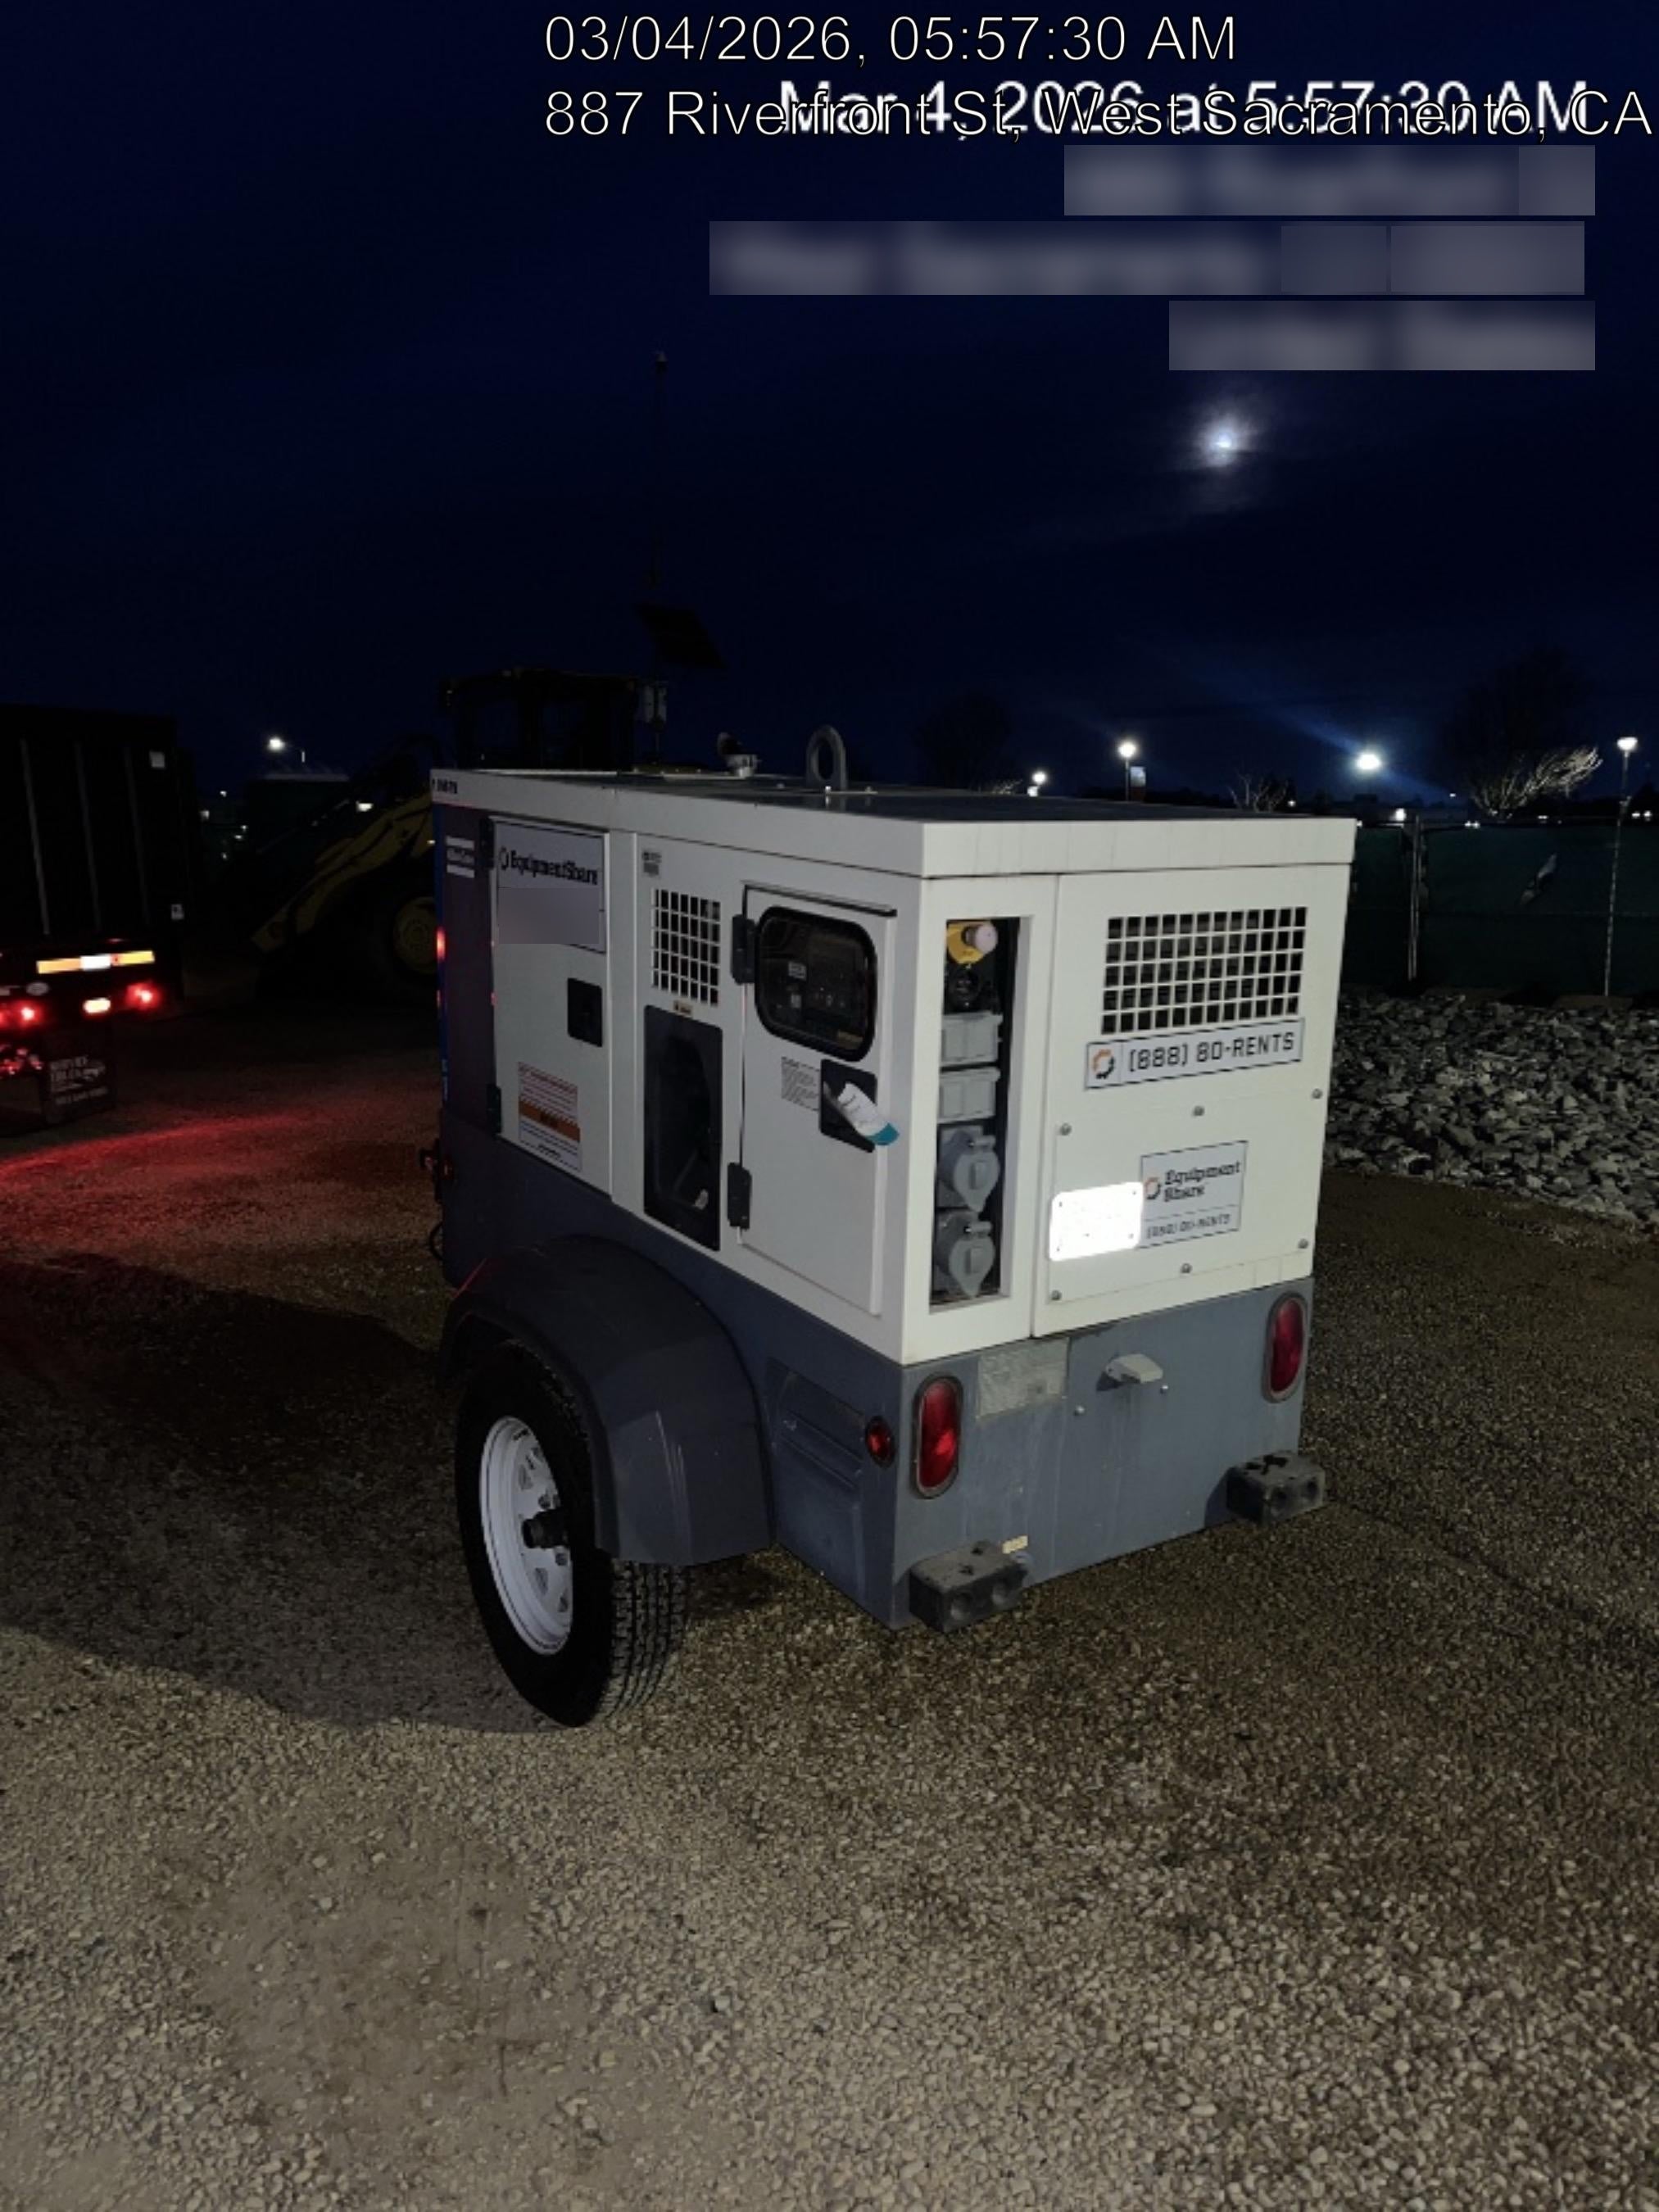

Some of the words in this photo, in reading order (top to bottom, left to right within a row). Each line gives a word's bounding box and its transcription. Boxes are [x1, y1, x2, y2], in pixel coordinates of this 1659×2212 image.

[1196, 1031, 1294, 1063] 80-RENTS
[1164, 1161, 1241, 1185] Equipment
[1163, 1185, 1206, 1203] Share
